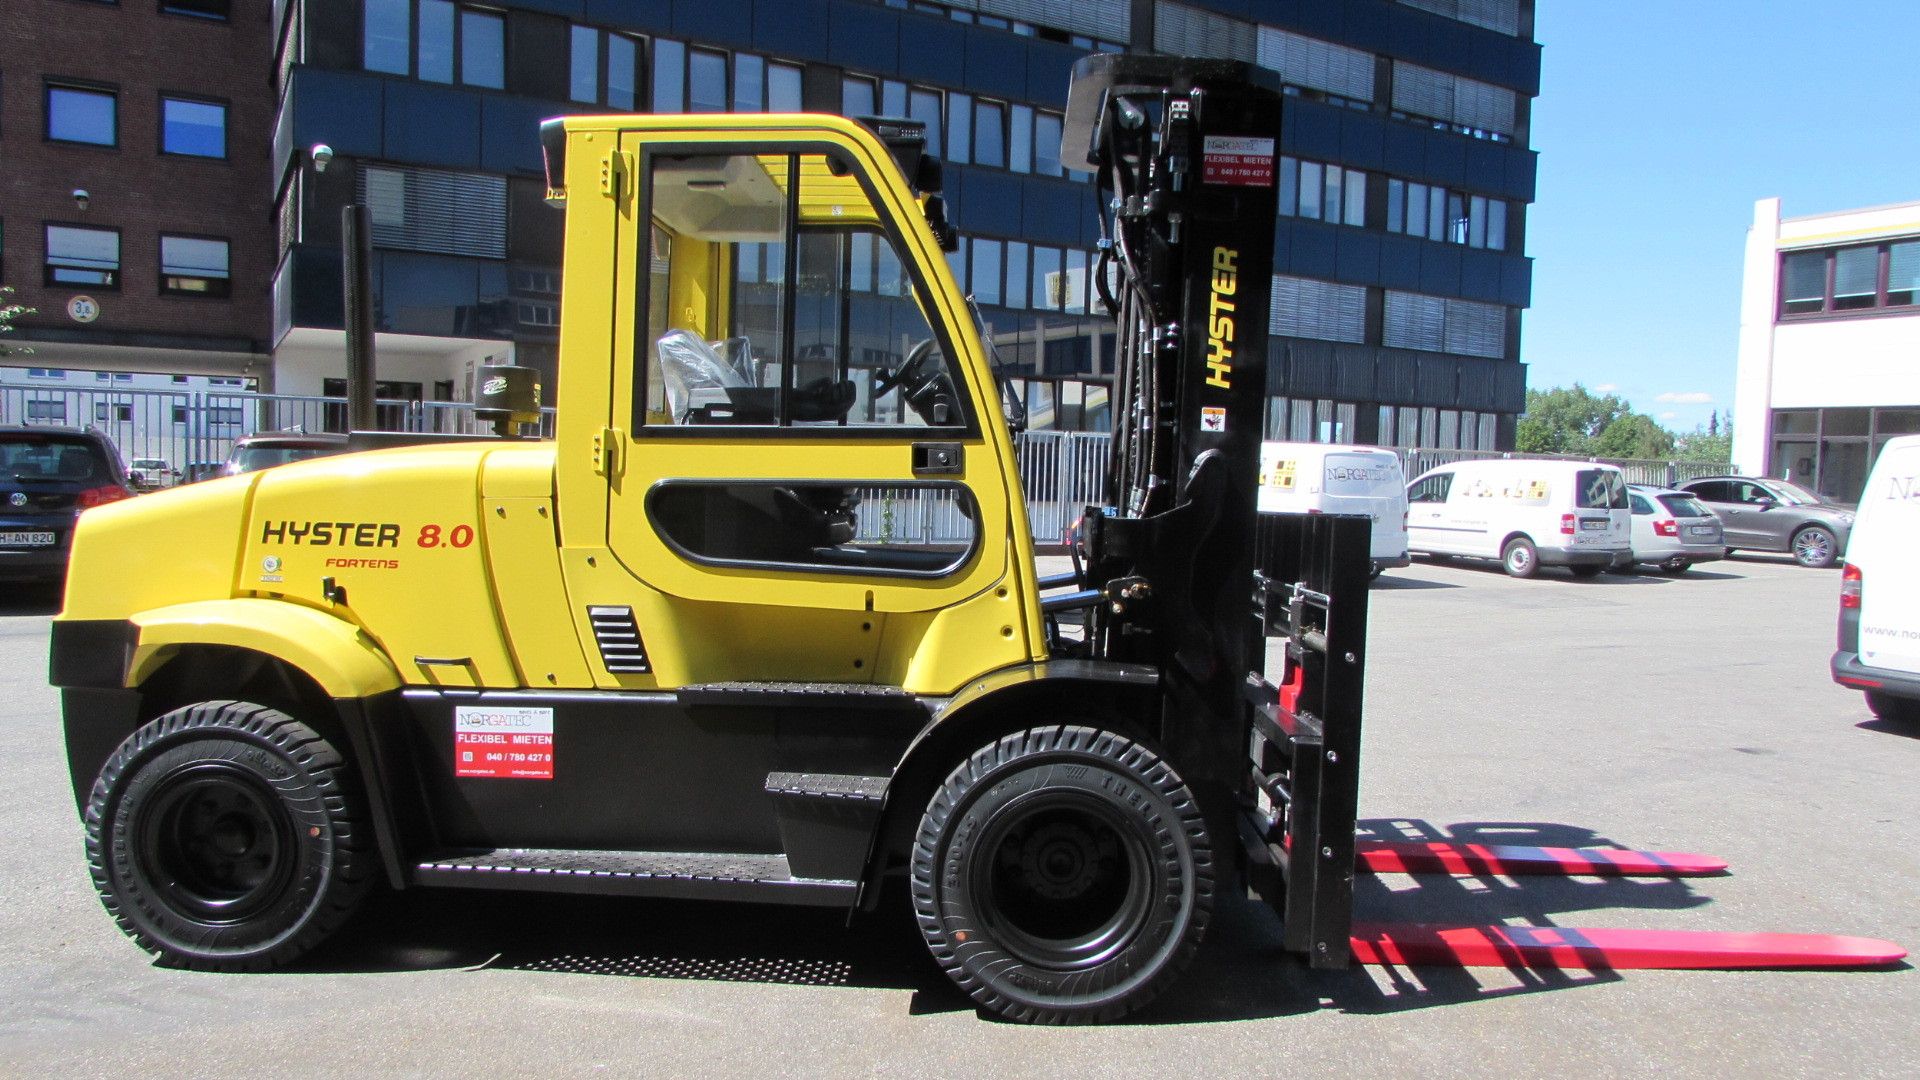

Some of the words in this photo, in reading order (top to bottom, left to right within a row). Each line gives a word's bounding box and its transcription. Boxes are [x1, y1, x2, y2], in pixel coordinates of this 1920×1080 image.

[1204, 155, 1240, 164] FLEXIBEL
[1243, 157, 1272, 165] MIETEN
[1205, 246, 1239, 389] HYSTER
[14, 534, 29, 543] AN
[261, 520, 401, 548] HYSTER
[416, 524, 474, 549] 8.0
[325, 558, 399, 569] FORTENS
[1863, 625, 1920, 641] www.no
[457, 734, 507, 744] FLEXIBEL
[512, 735, 552, 745] MIETEN
[486, 752, 502, 761] 040
[510, 753, 525, 761] 780
[527, 753, 543, 762] 427
[545, 754, 551, 762] 0
